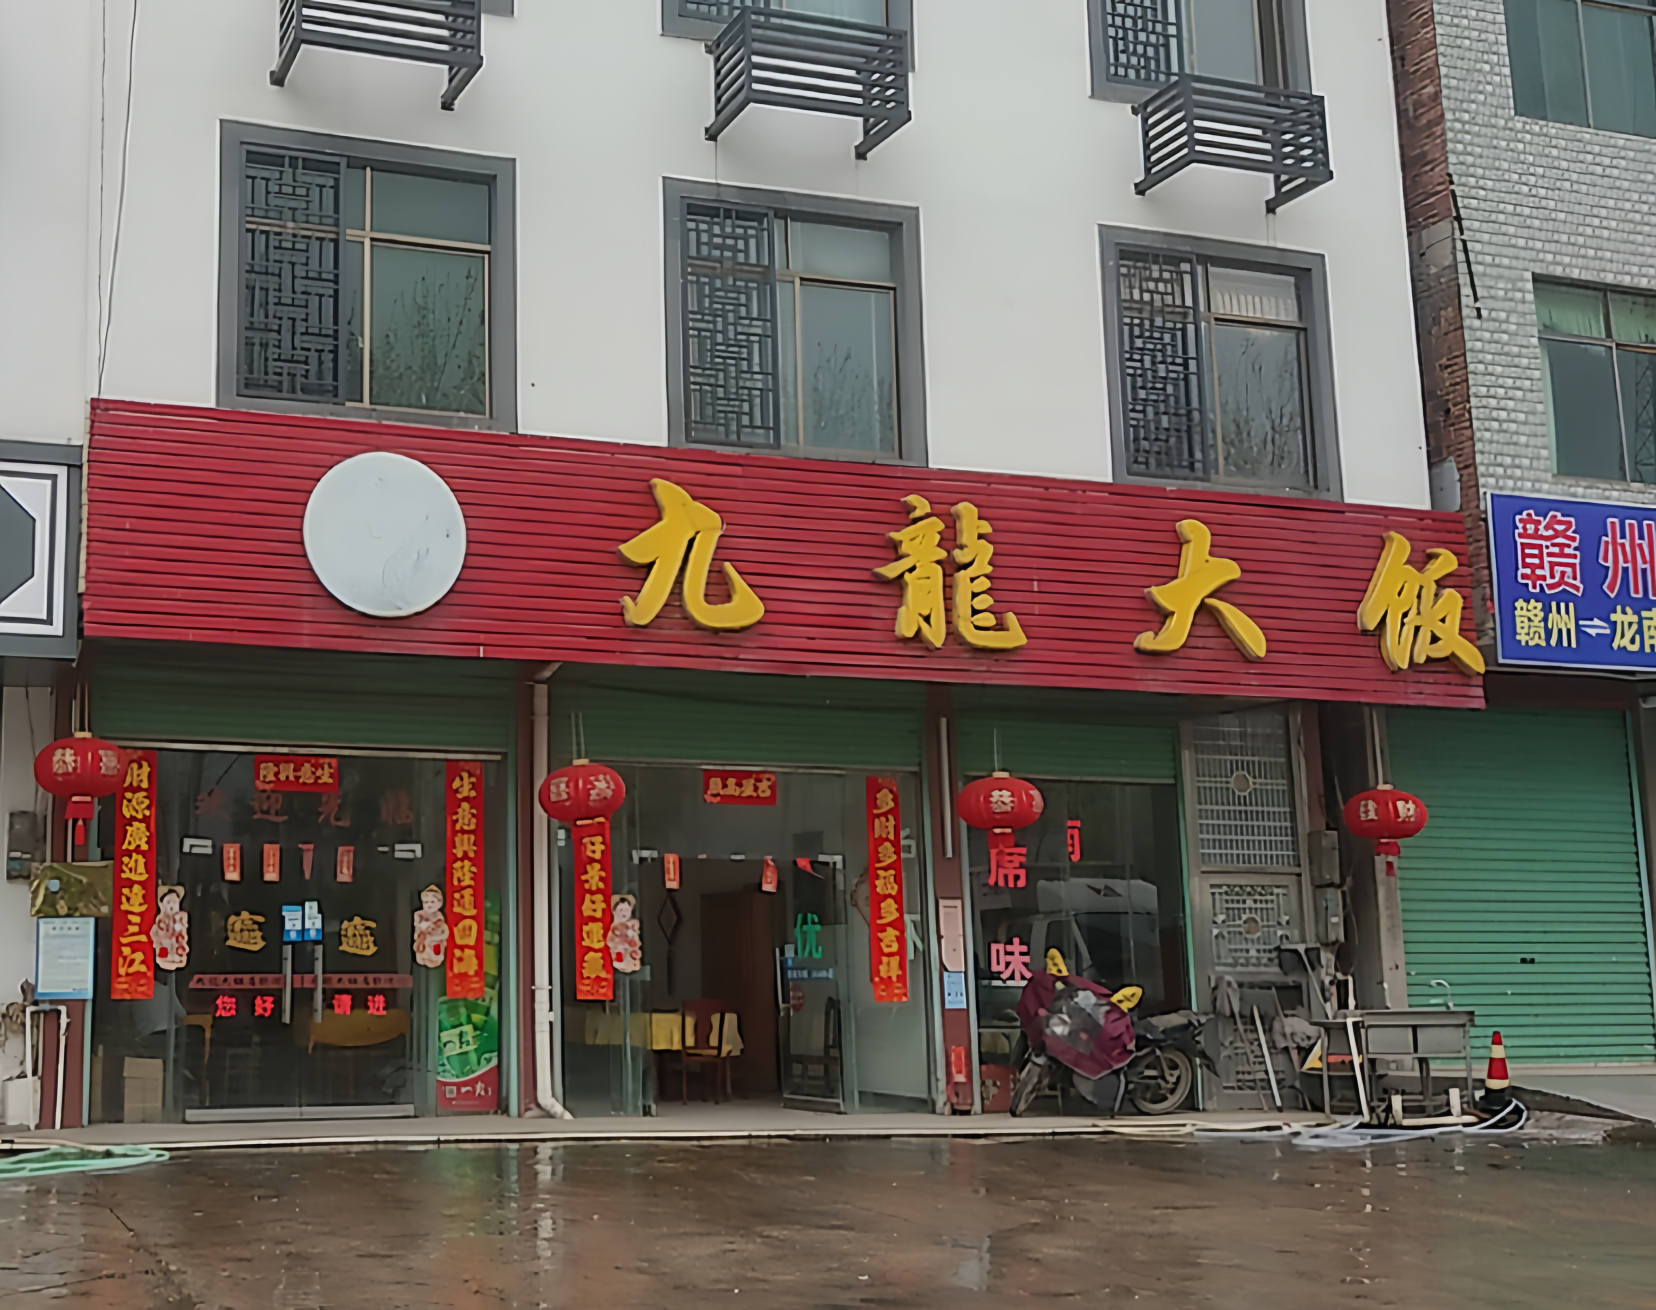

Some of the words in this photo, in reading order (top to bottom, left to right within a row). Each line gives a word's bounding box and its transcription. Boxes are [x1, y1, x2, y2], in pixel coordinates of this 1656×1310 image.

[1514, 509, 1656, 600] 赣州
[1514, 598, 1577, 649] 赣州
[988, 846, 1027, 888] 席
[794, 912, 823, 959] 优
[990, 936, 1033, 982] 味
